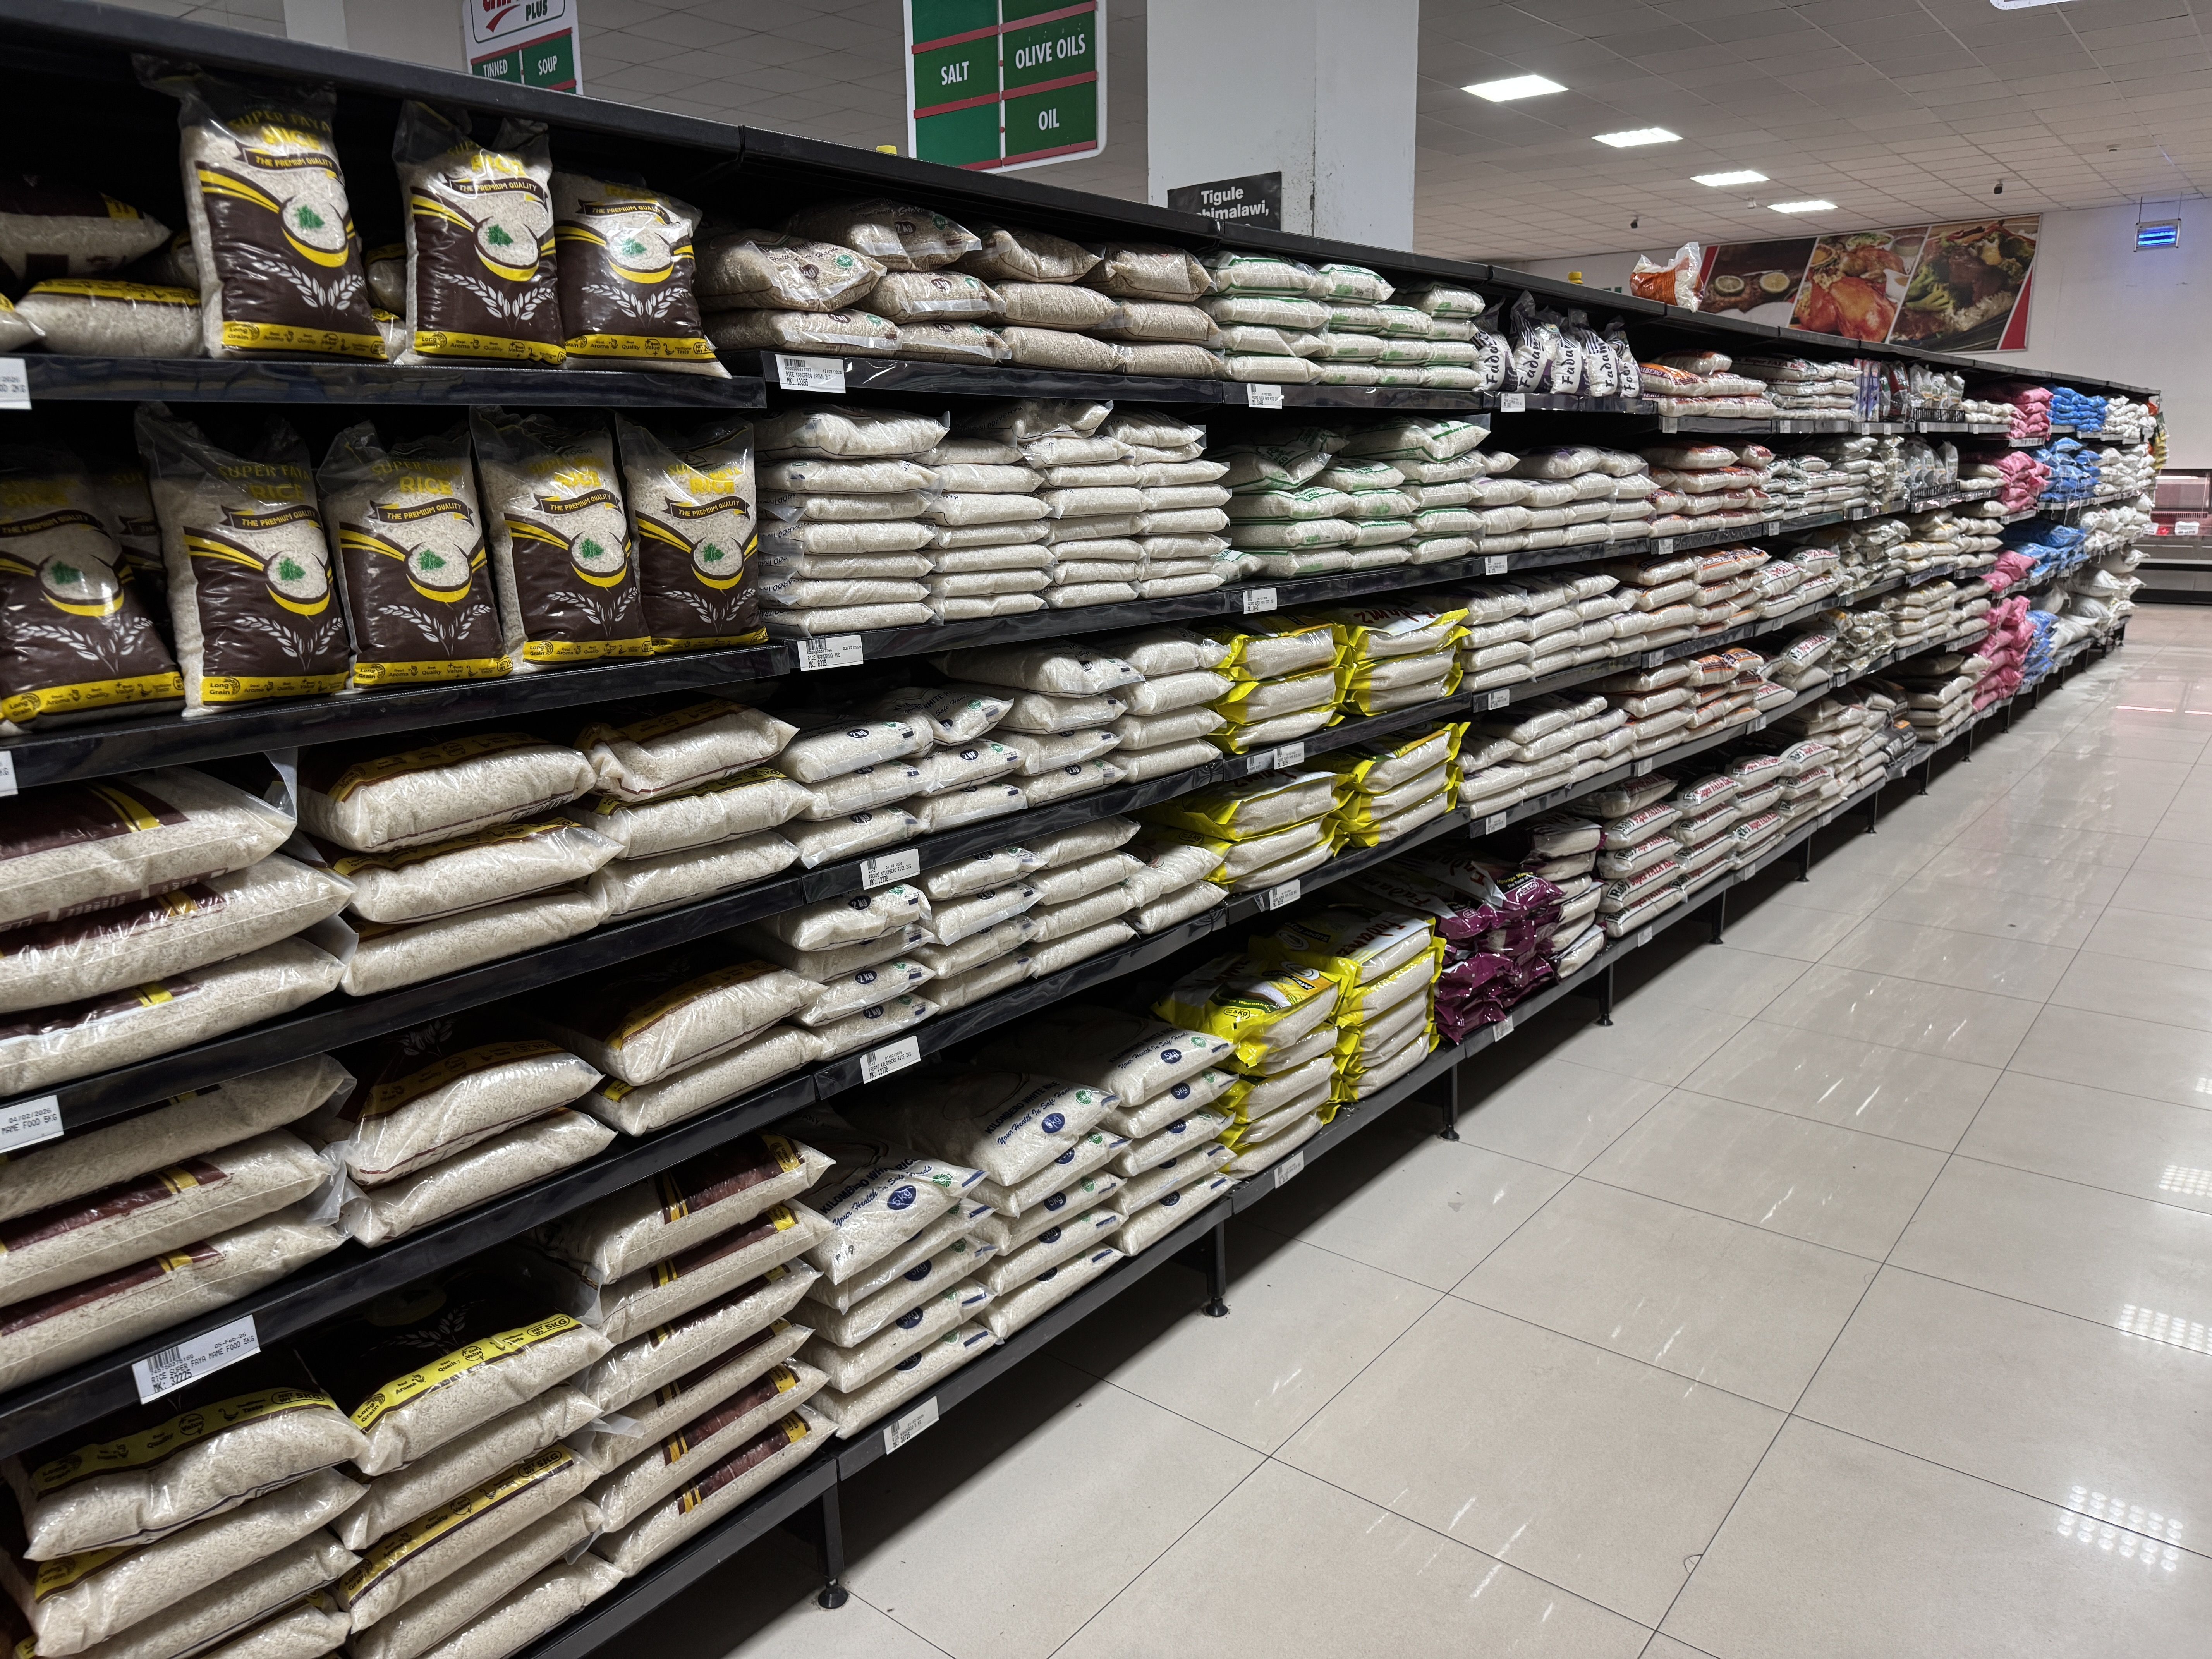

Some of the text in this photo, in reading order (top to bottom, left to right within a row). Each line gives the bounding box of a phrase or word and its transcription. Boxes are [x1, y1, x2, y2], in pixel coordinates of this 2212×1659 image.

[526, 2, 548, 21] PLUS
[1015, 34, 1086, 69] OLIVE OILS
[483, 59, 508, 78] TINNED
[538, 55, 558, 76] SOUP
[941, 61, 969, 86] SALT
[1038, 108, 1060, 131] OIL
[477, 182, 507, 192] PREMIUM
[509, 181, 537, 191] QUALITY
[1201, 187, 1244, 206] Tigule
[607, 206, 637, 214] PREMIUM
[638, 206, 665, 216] QUALITY
[1196, 200, 1269, 220] himalawi,
[249, 483, 305, 500] RICE
[400, 476, 453, 496] RICE
[689, 478, 735, 494] RICE
[404, 507, 435, 519] PREMIUM
[436, 503, 462, 512] QUALITY
[565, 499, 590, 511] PREMIUM
[590, 494, 611, 504] QUALITY
[692, 504, 718, 516] PREMIUM
[718, 500, 740, 509] QUALITY
[242, 510, 315, 527] THE PREMIUM QUALITY
[878, 875, 889, 884] 12778
[881, 1057, 897, 1067] KILOMBERO
[1118, 1059, 1133, 1069] Your
[1132, 1048, 1152, 1060] Health
[1159, 1039, 1173, 1048] Safe
[1164, 1051, 1180, 1060] 5kg
[878, 1066, 889, 1076] 12778
[1174, 1085, 1188, 1096] 5kg
[8, 1108, 52, 1124] 04/02/2026
[986, 1103, 1023, 1134] KILOMBERO
[1022, 1089, 1042, 1105] WHITE
[1, 1113, 58, 1135] MAME FOOD 5KG
[997, 1098, 1055, 1145] Your Health In Safe
[820, 1179, 869, 1215] KILOMBERO
[833, 1210, 852, 1227] Your
[852, 1191, 879, 1211] Health
[888, 1172, 905, 1185] Safe
[891, 1188, 913, 1207] 5kg
[1048, 1193, 1064, 1207] 5kg
[545, 1317, 568, 1330] 5KG
[903, 1310, 920, 1325] 5kg
[214, 1332, 247, 1349] 05-Feb-26
[151, 1371, 167, 1384] RICE
[191, 1355, 207, 1367] FAYA
[208, 1348, 224, 1359] MAME
[226, 1340, 241, 1352] FOOD
[244, 1335, 255, 1345] 5KG
[464, 1350, 483, 1360] Value
[437, 1360, 461, 1372] Quality
[395, 1382, 417, 1395] Aroma
[357, 1401, 376, 1419] Long
[361, 1405, 380, 1422] Grain
[537, 1451, 560, 1466] 5KG
